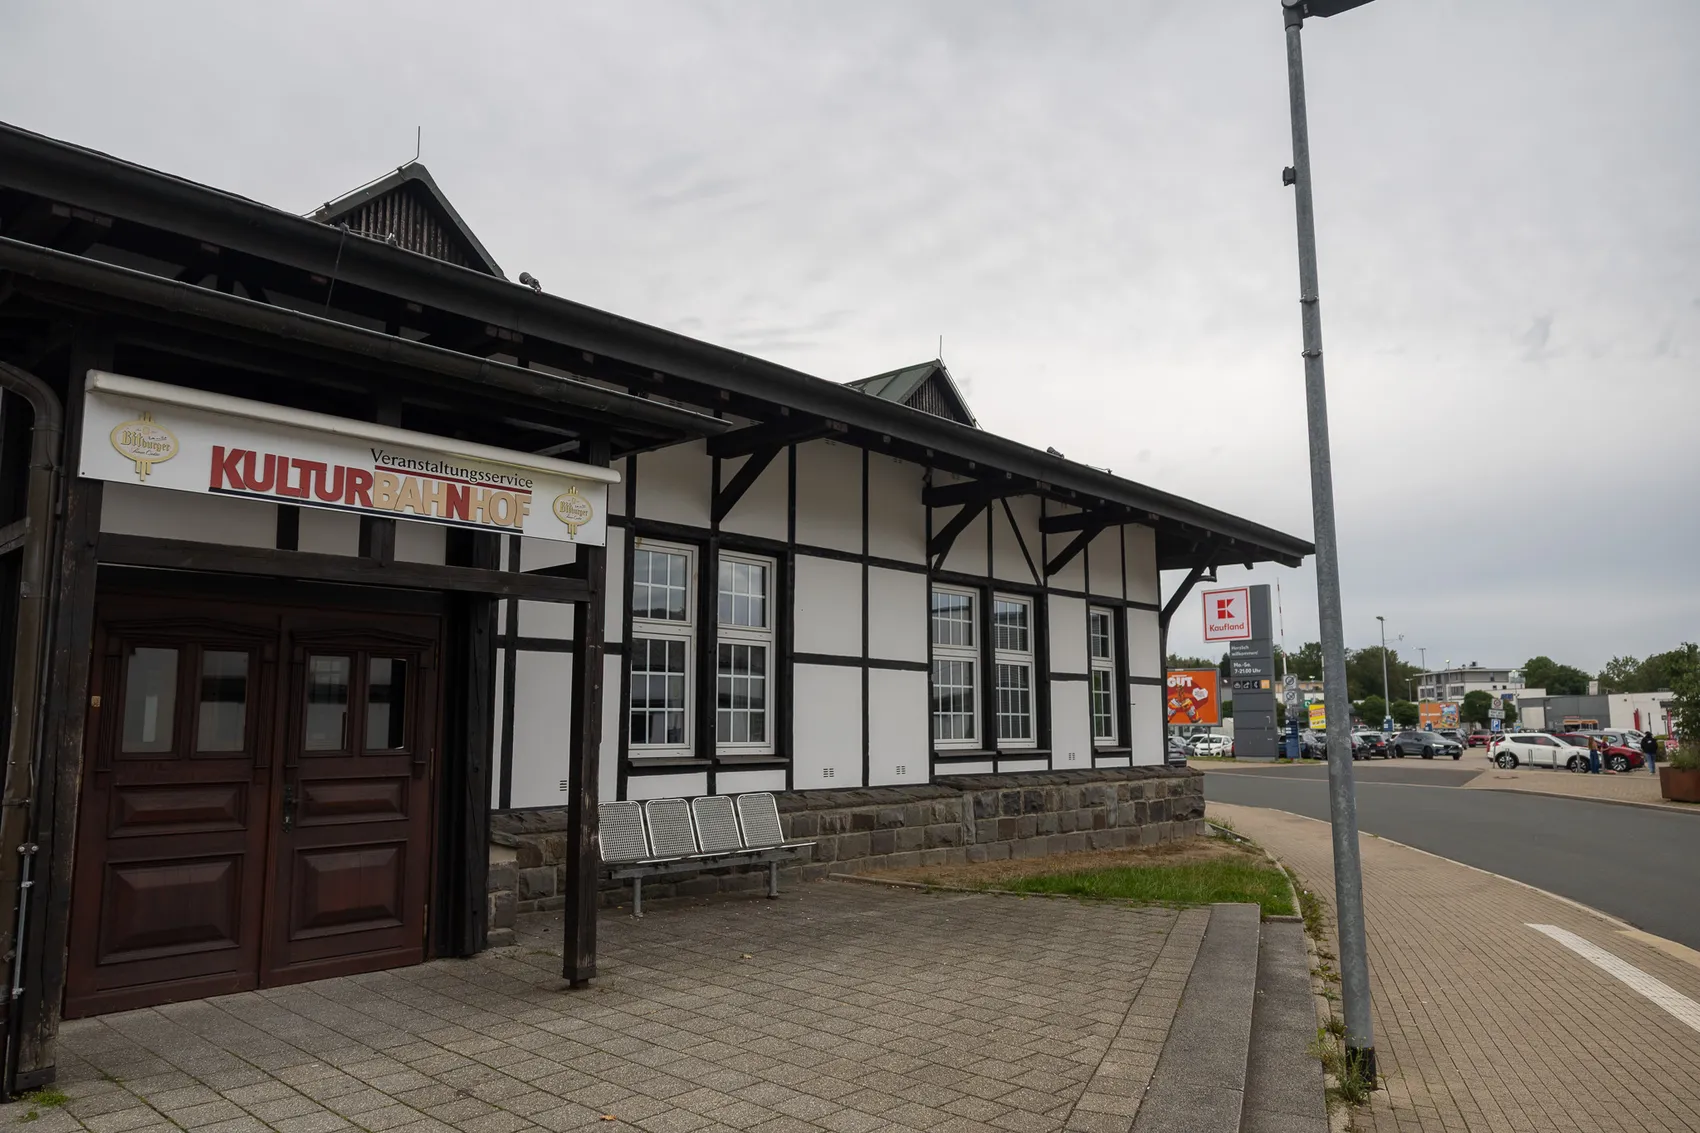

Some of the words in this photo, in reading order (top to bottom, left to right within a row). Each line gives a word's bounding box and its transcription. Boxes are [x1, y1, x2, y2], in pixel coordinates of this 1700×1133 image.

[120, 430, 171, 452] Bitburger
[370, 448, 533, 489] Veranstaltungsservice
[210, 445, 532, 528] KULTURBAHNHOF
[559, 501, 589, 517] Bitburger
[1209, 622, 1245, 632] Kaufland
